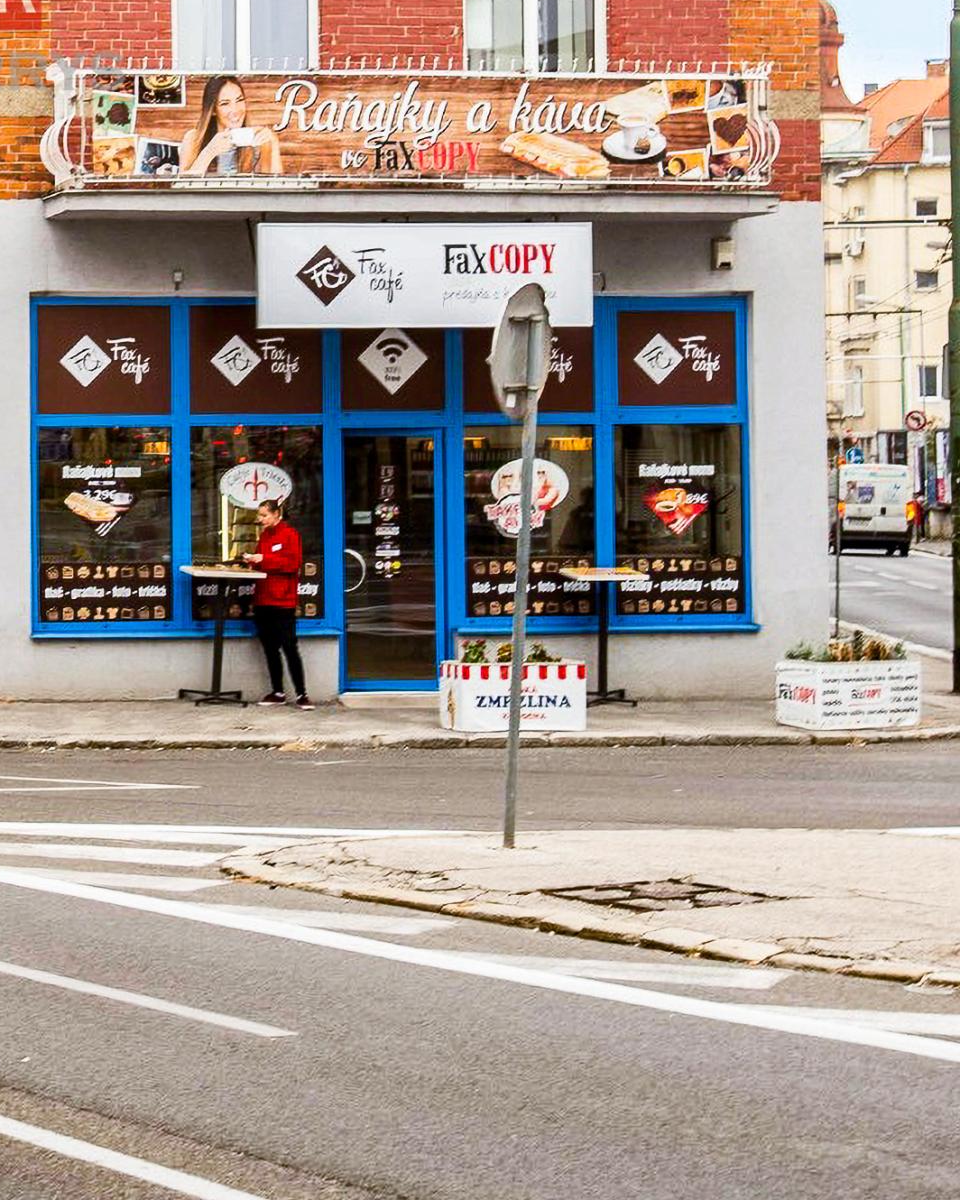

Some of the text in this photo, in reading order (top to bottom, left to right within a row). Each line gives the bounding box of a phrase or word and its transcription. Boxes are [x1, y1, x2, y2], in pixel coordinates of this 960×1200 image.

[273, 79, 618, 150] Raňajky a káva
[342, 149, 367, 170] vo
[352, 247, 387, 275] Fax
[370, 268, 403, 303] café
[106, 337, 136, 362] Fax
[256, 337, 287, 362] Fax
[678, 335, 708, 362] Fax
[121, 355, 151, 385] café
[270, 355, 300, 384] café
[691, 351, 721, 383] café
